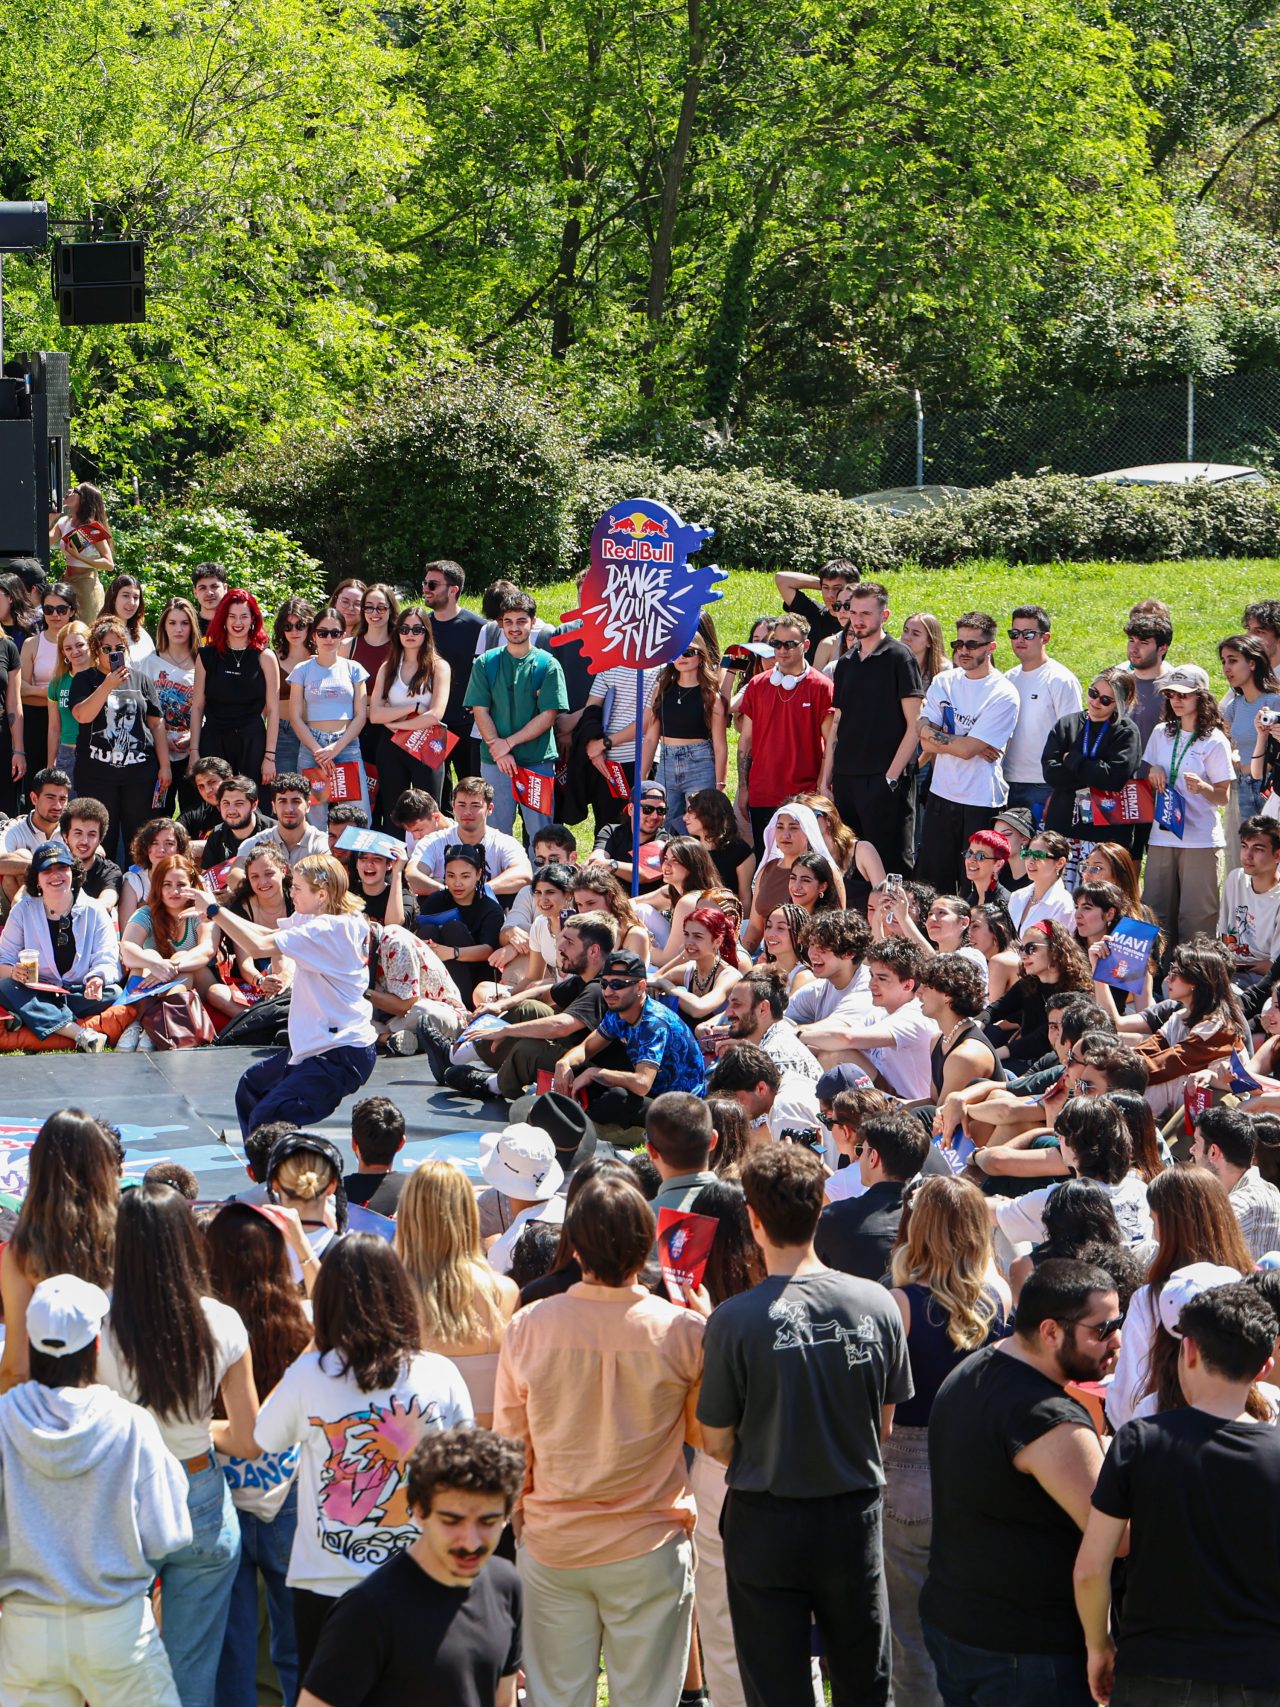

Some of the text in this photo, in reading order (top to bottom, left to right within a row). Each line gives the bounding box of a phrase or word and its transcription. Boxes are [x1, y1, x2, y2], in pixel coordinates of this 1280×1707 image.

[602, 539, 674, 563] Red Bull
[601, 563, 673, 599] DANCE
[607, 587, 679, 626] YOUR
[601, 612, 674, 661] STYLE
[89, 745, 147, 765] TUPAC
[336, 766, 347, 798] KIRMIZI
[533, 777, 542, 809] KIRMIZI
[1127, 783, 1140, 819] KIRMIZI
